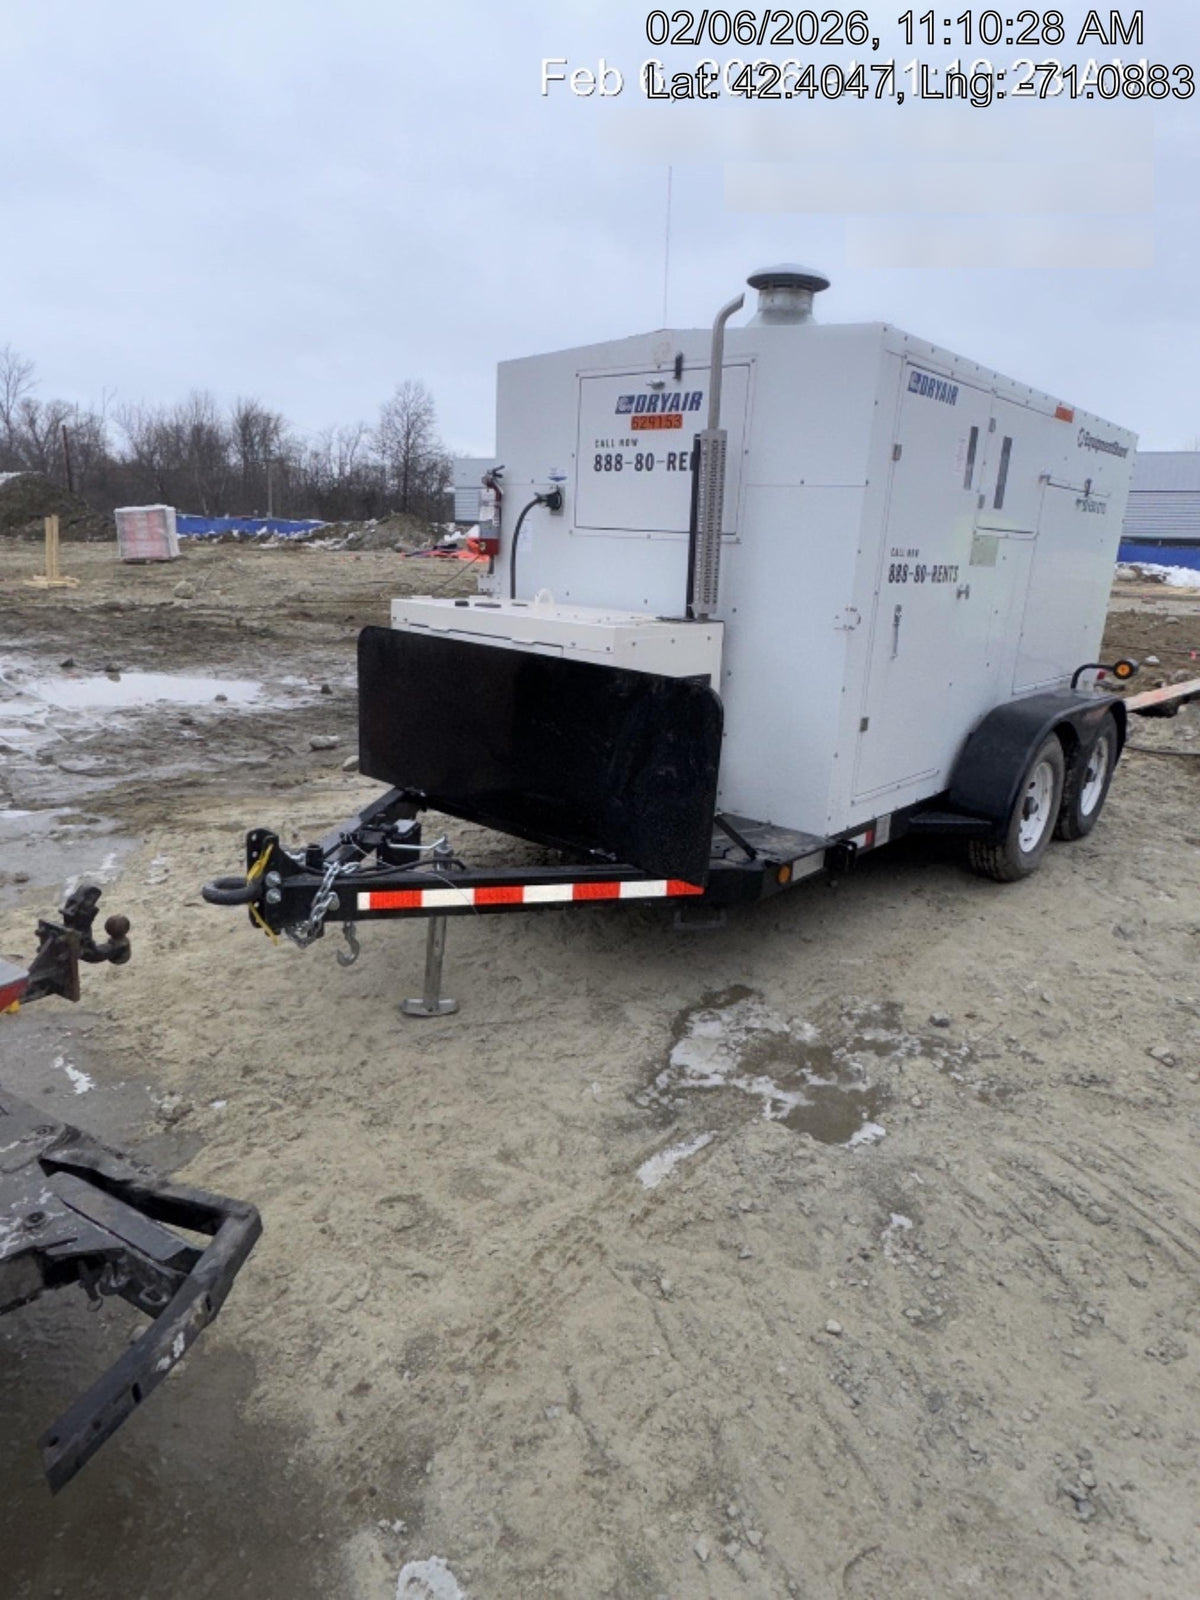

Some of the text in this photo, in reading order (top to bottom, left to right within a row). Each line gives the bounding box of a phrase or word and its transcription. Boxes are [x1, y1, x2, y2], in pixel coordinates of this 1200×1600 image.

[919, 375, 960, 406] DRYAIR
[633, 391, 703, 413] DRYAIR
[631, 415, 682, 430] 629153
[595, 438, 639, 449] CALL NOW
[593, 451, 695, 472] 888-80-RE
